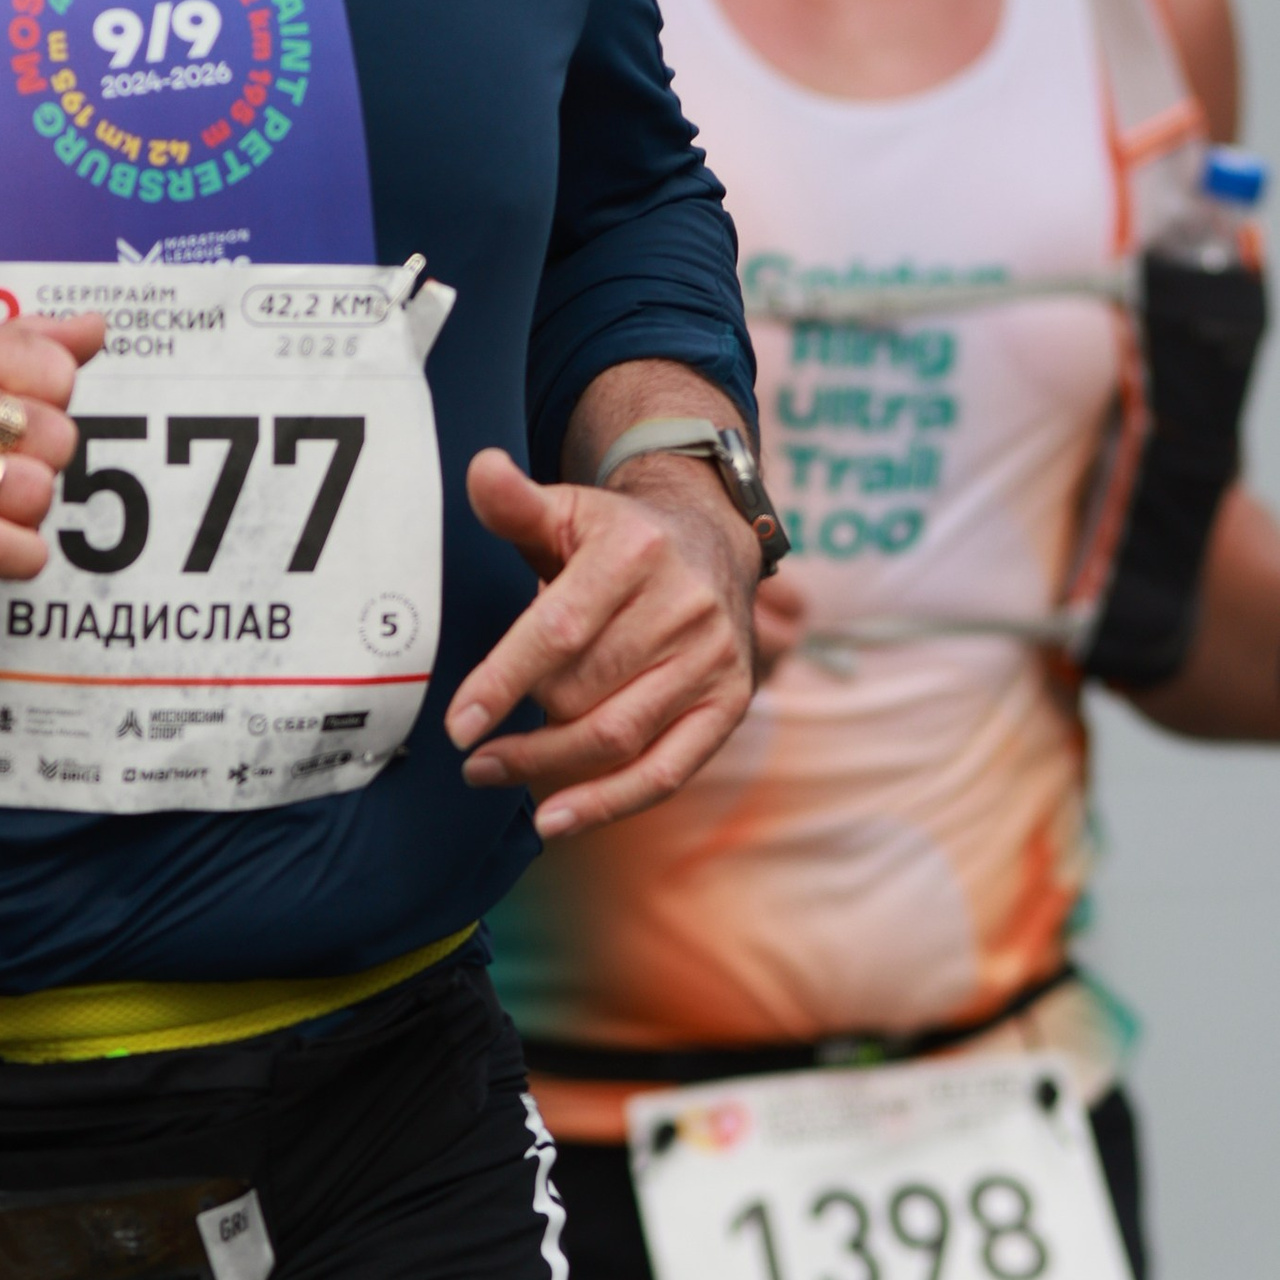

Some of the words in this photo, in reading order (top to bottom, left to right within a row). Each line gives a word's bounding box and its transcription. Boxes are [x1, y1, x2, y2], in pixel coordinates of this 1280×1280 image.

[47, 30, 68, 63] m
[247, 8, 273, 62] km
[50, 67, 96, 128] 195
[101, 60, 233, 99] 2024-2026
[230, 69, 274, 126] 195
[95, 119, 143, 162] km
[201, 118, 232, 149] m
[32, 104, 293, 204] PETERSBURG
[148, 139, 191, 167] 42
[164, 228, 251, 249] MARATHON
[165, 244, 225, 263] LEAGUE
[36, 283, 177, 304] СБЕРПРАЙМ
[259, 294, 319, 319] 42,2
[277, 335, 359, 357] 2026
[777, 385, 957, 431] Ultra
[781, 442, 941, 493] Trail
[7, 602, 293, 648] ВЛАДИСЛАВ
[381, 612, 398, 637] 5
